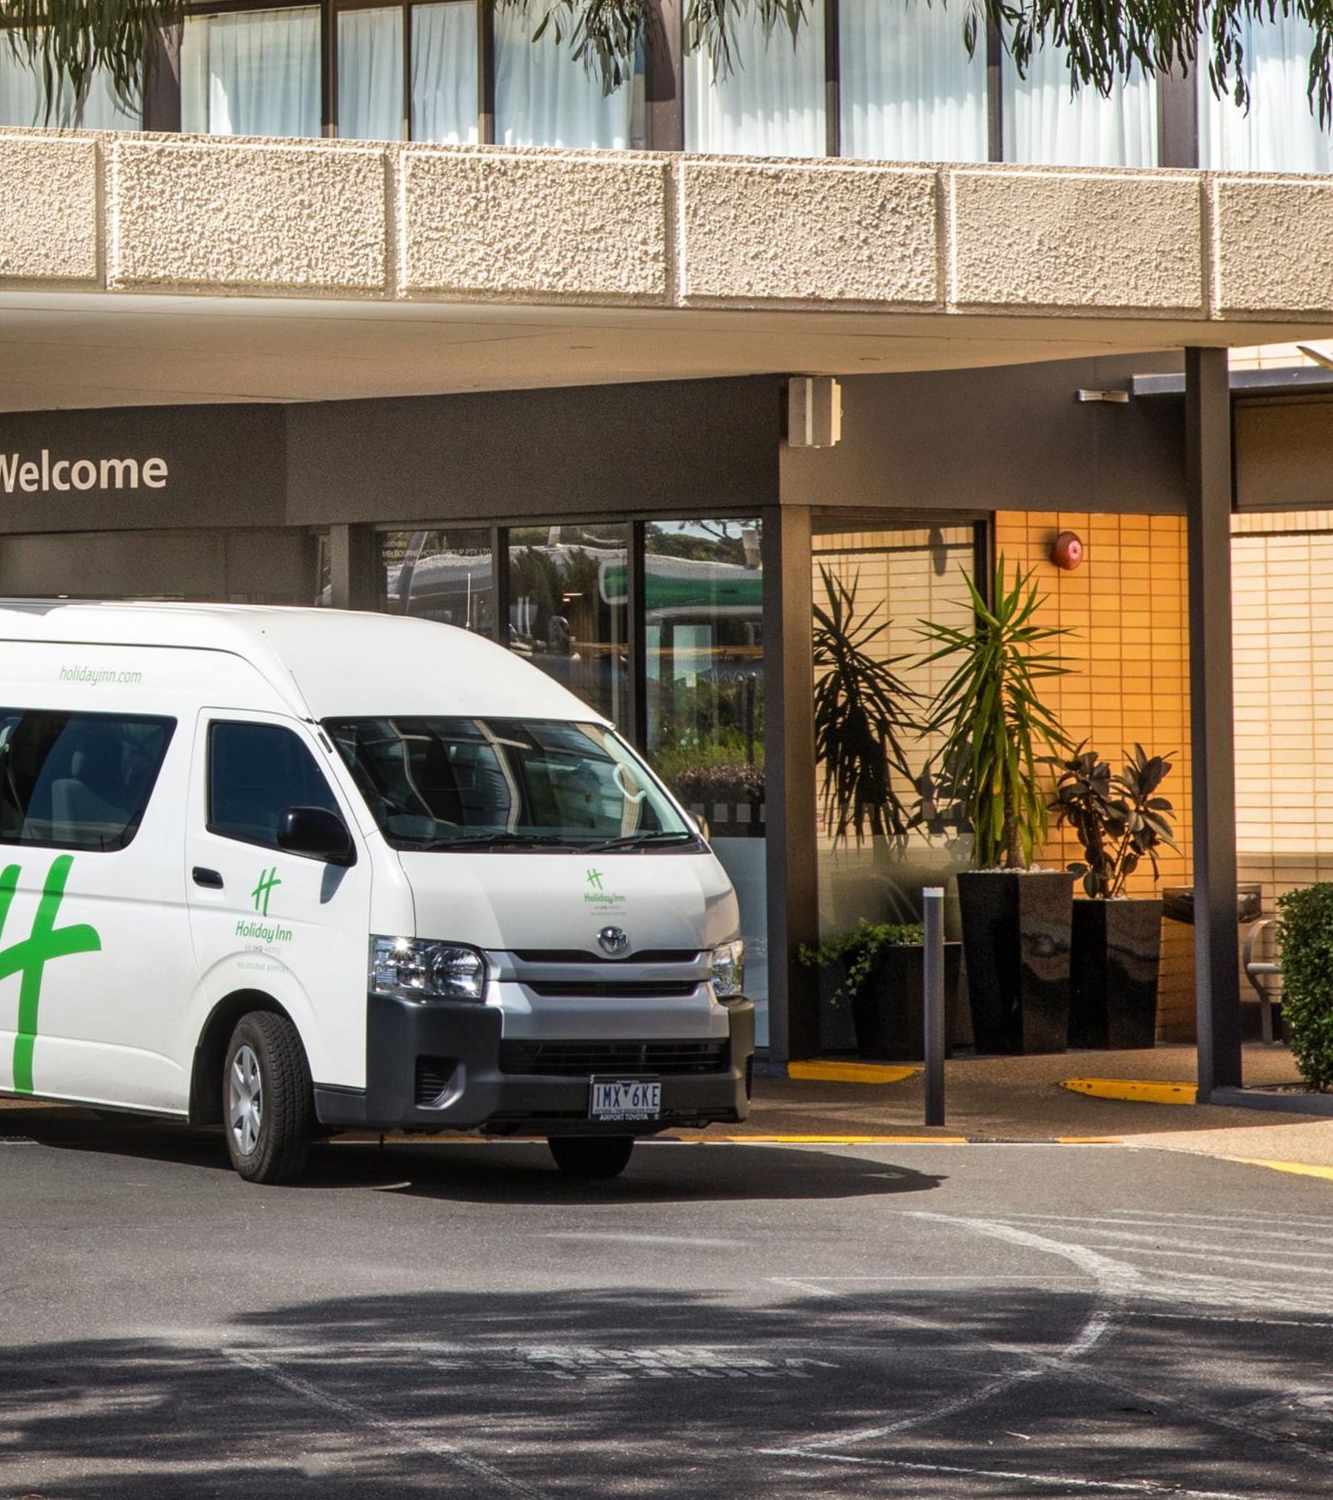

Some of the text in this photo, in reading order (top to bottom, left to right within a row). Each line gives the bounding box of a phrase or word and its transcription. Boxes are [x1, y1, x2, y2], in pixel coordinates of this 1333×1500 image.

[59, 665, 142, 686] holidayinn.com
[235, 920, 292, 944] Holiday Inn
[597, 1086, 659, 1108] 1MX 6KE
